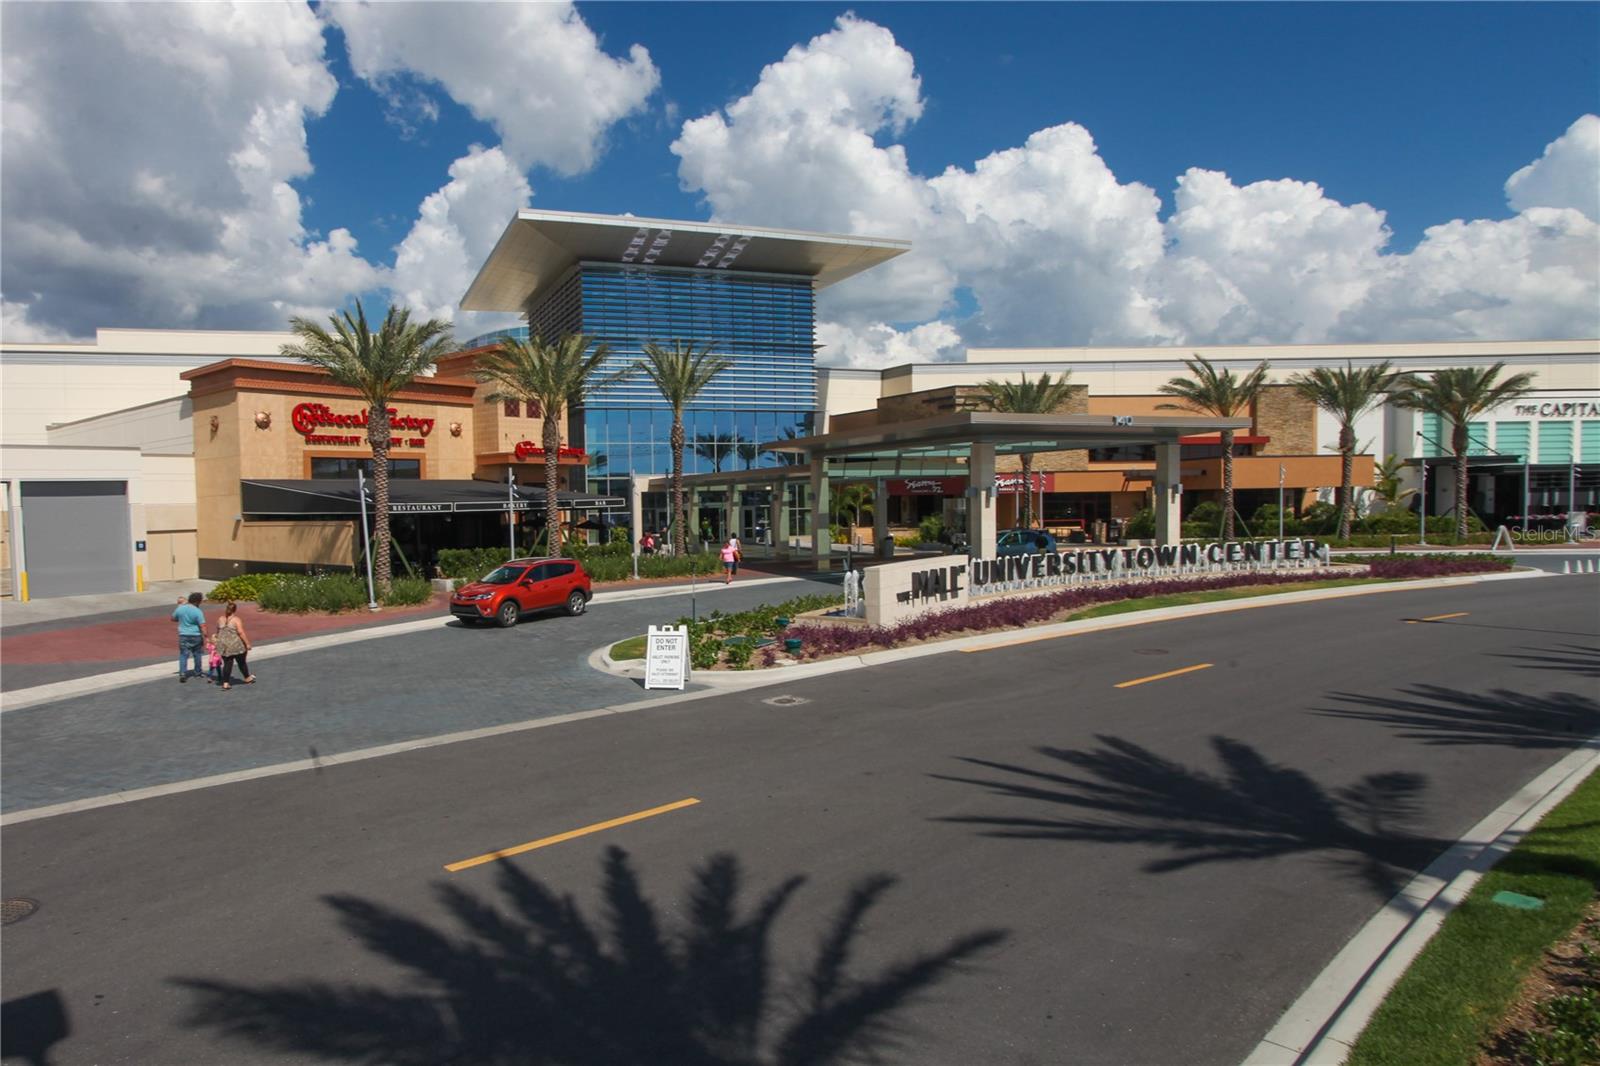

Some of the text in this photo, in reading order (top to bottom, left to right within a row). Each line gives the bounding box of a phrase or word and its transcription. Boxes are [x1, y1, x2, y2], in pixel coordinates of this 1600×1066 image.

[1515, 403, 1600, 417] THE CAPITA
[972, 548, 1117, 586] UNIVERSITY
[1120, 544, 1198, 570] TOWN
[1206, 538, 1320, 563] CENTER
